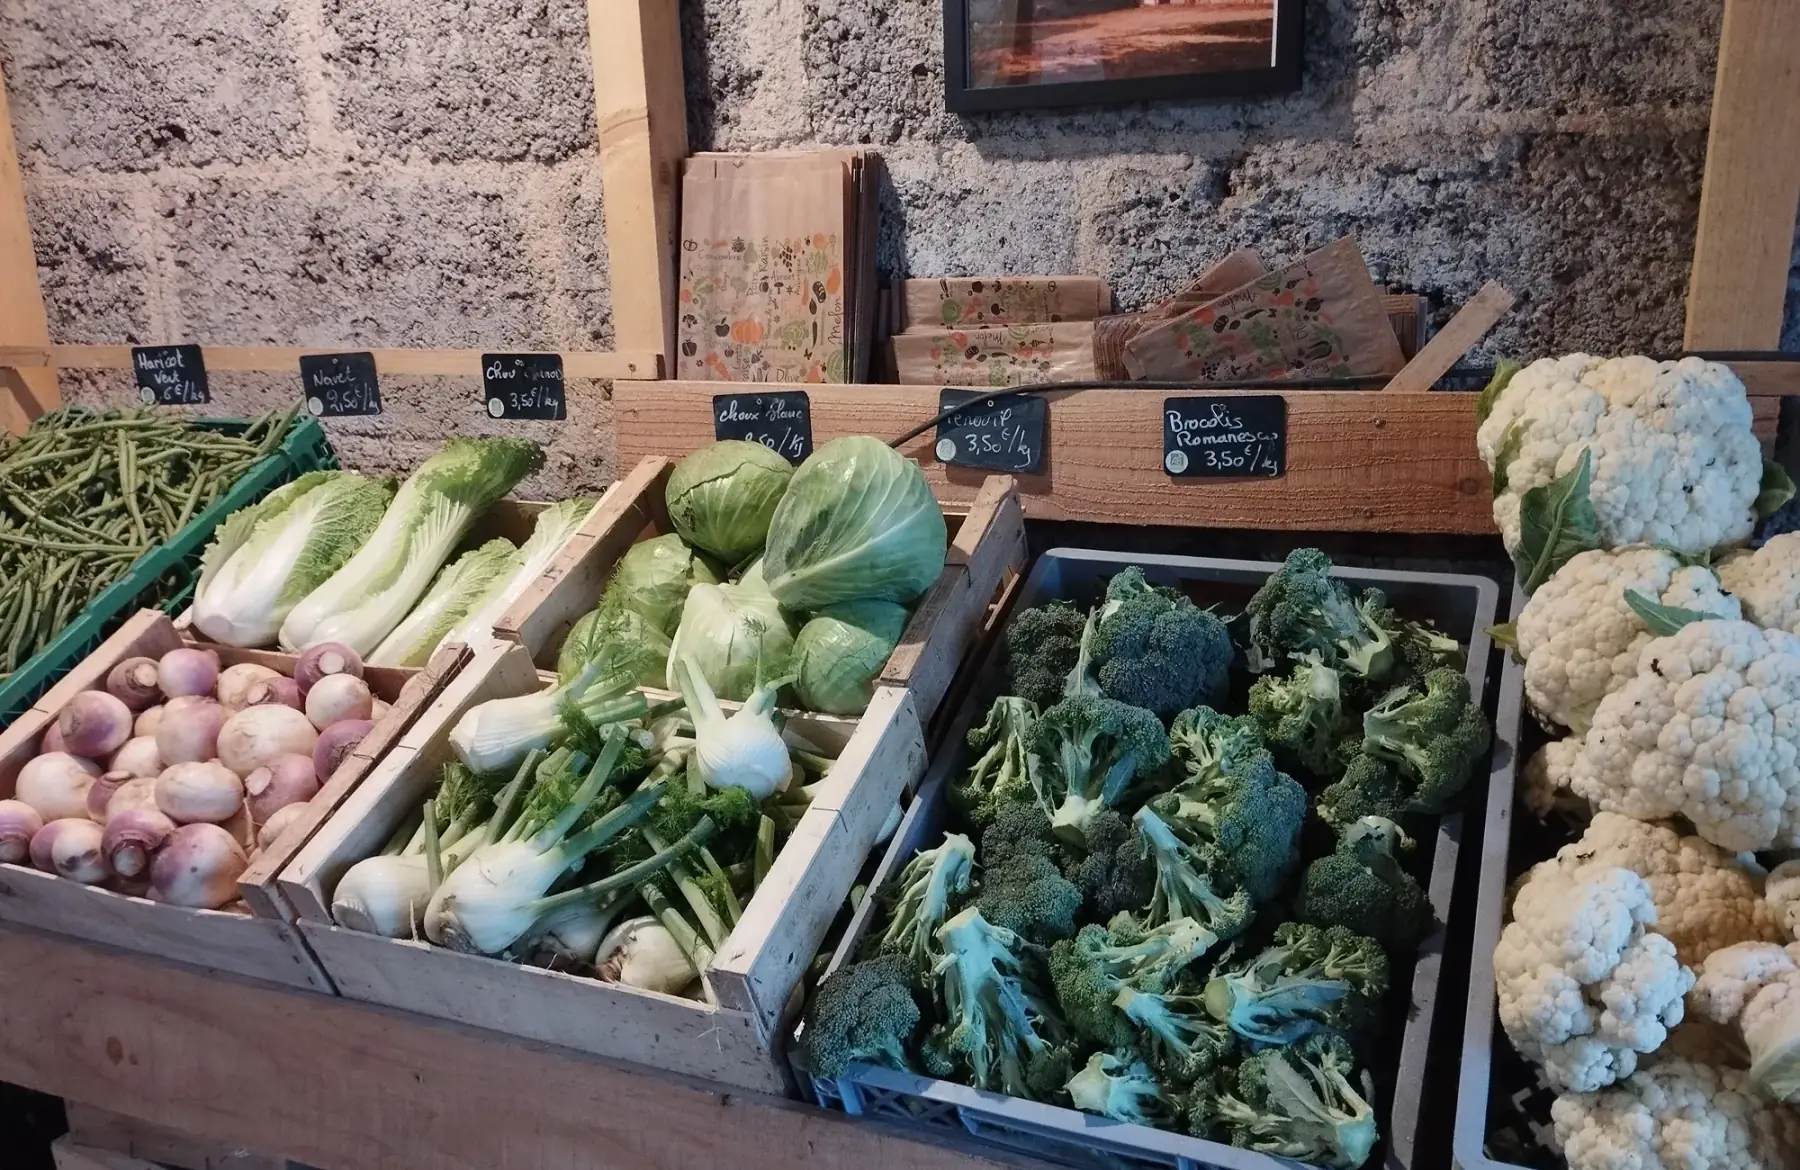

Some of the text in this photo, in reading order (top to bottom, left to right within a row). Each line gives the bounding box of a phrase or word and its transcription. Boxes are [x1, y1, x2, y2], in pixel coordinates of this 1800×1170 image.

[827, 297, 844, 346] Melon
[137, 348, 185, 370] Haricot
[486, 360, 516, 380] Chou
[152, 370, 180, 384] Vert
[313, 365, 356, 387] Navet
[1166, 403, 1243, 433] Brocolis
